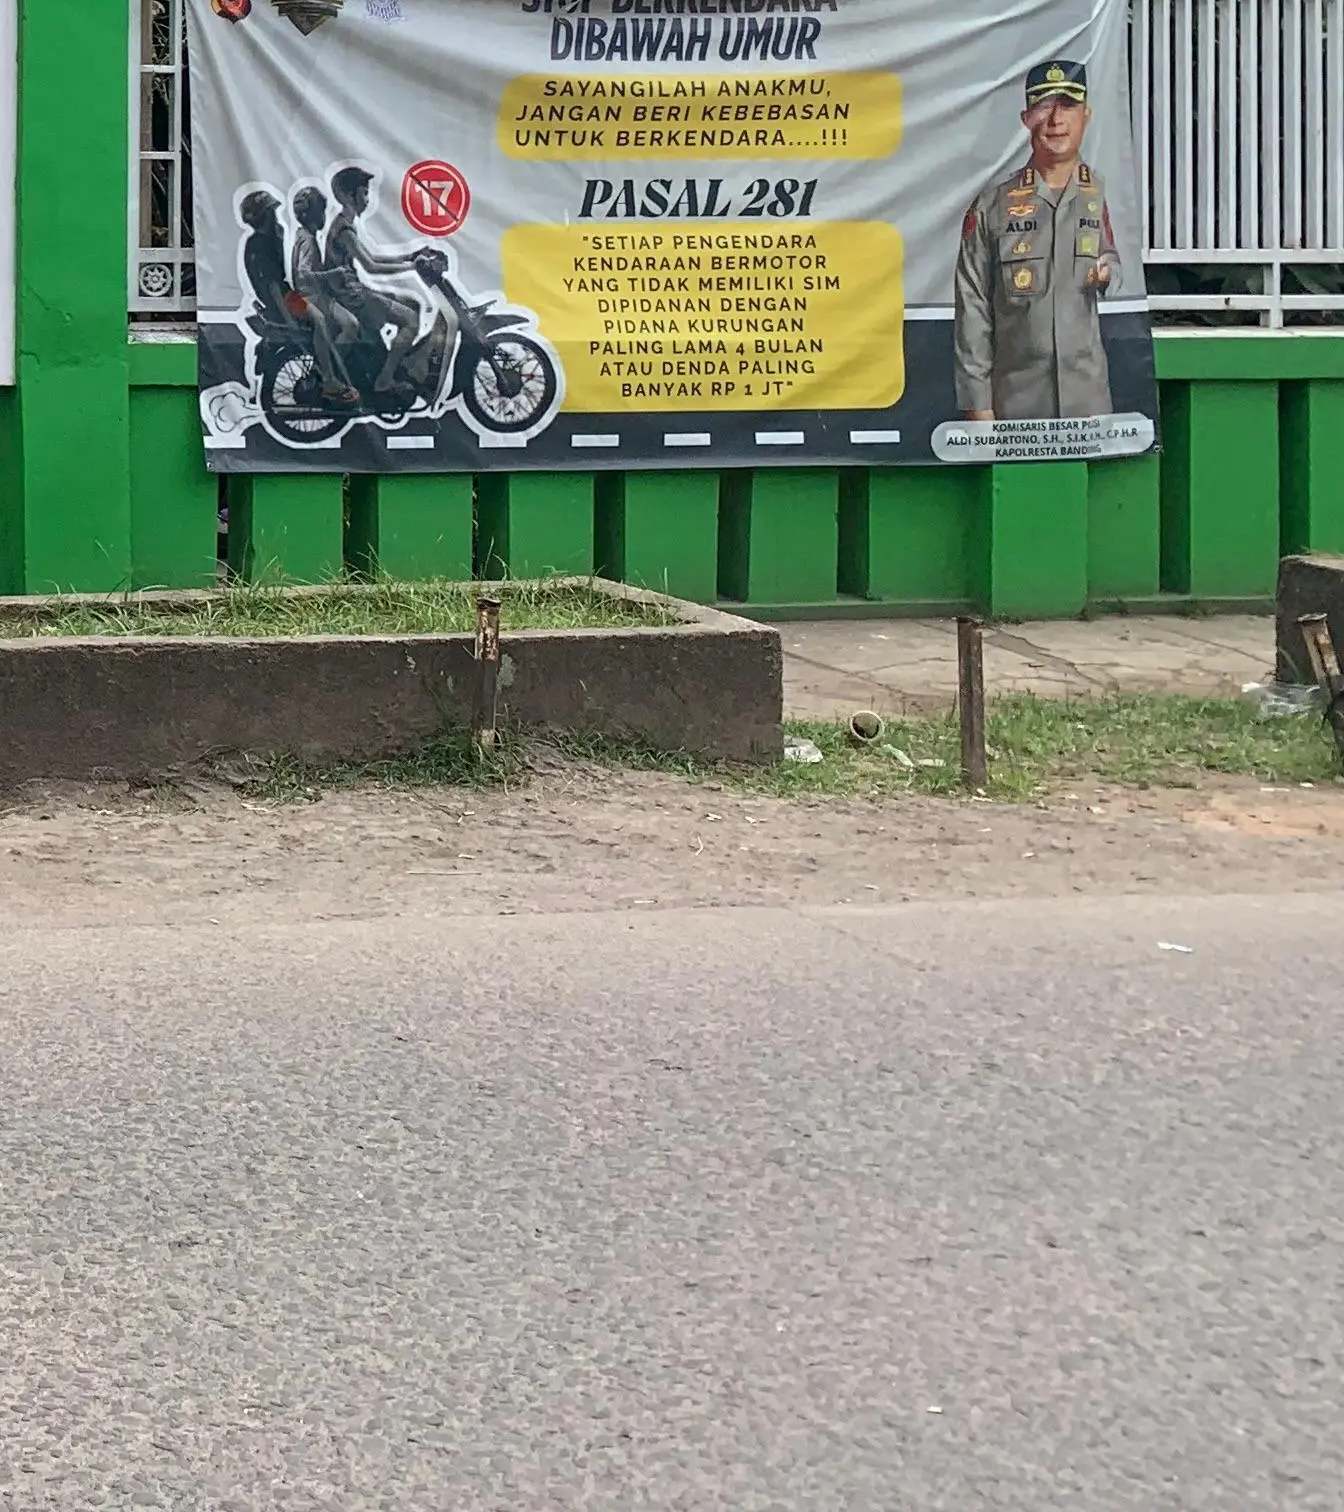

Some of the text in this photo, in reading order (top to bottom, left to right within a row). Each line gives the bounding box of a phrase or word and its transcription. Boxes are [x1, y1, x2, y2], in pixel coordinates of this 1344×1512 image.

[550, 17, 821, 62] DIBAWAH UMUR
[543, 79, 831, 98] SAYANGILAH ANAKMU,
[516, 103, 849, 122] JANGAN BERI KEBEBASAN
[516, 130, 604, 147] UNTUK
[415, 180, 454, 216] 17
[578, 178, 819, 218] PASAL 281
[1006, 221, 1037, 233] ALDI
[583, 235, 817, 250] "SETIAP PENGENDARA
[574, 255, 827, 271] KENDARAAN BERMOTOR
[563, 276, 840, 292] YANG TIDAK MEMILIKI SIM
[599, 297, 807, 313] DIPIDANAN DENGAN
[605, 318, 803, 334] PIDANA KURUNGAN
[590, 339, 823, 356] PALING LAMA 4 BULAN
[600, 360, 815, 377] ATAU DENDA PALING
[622, 381, 793, 397] BANYAK RP 1 JT"
[992, 423, 1046, 433] KOMISARIS
[1049, 421, 1078, 430] BESAR
[947, 436, 971, 446] ALDI
[995, 447, 1058, 457] KAPOLRESTA
